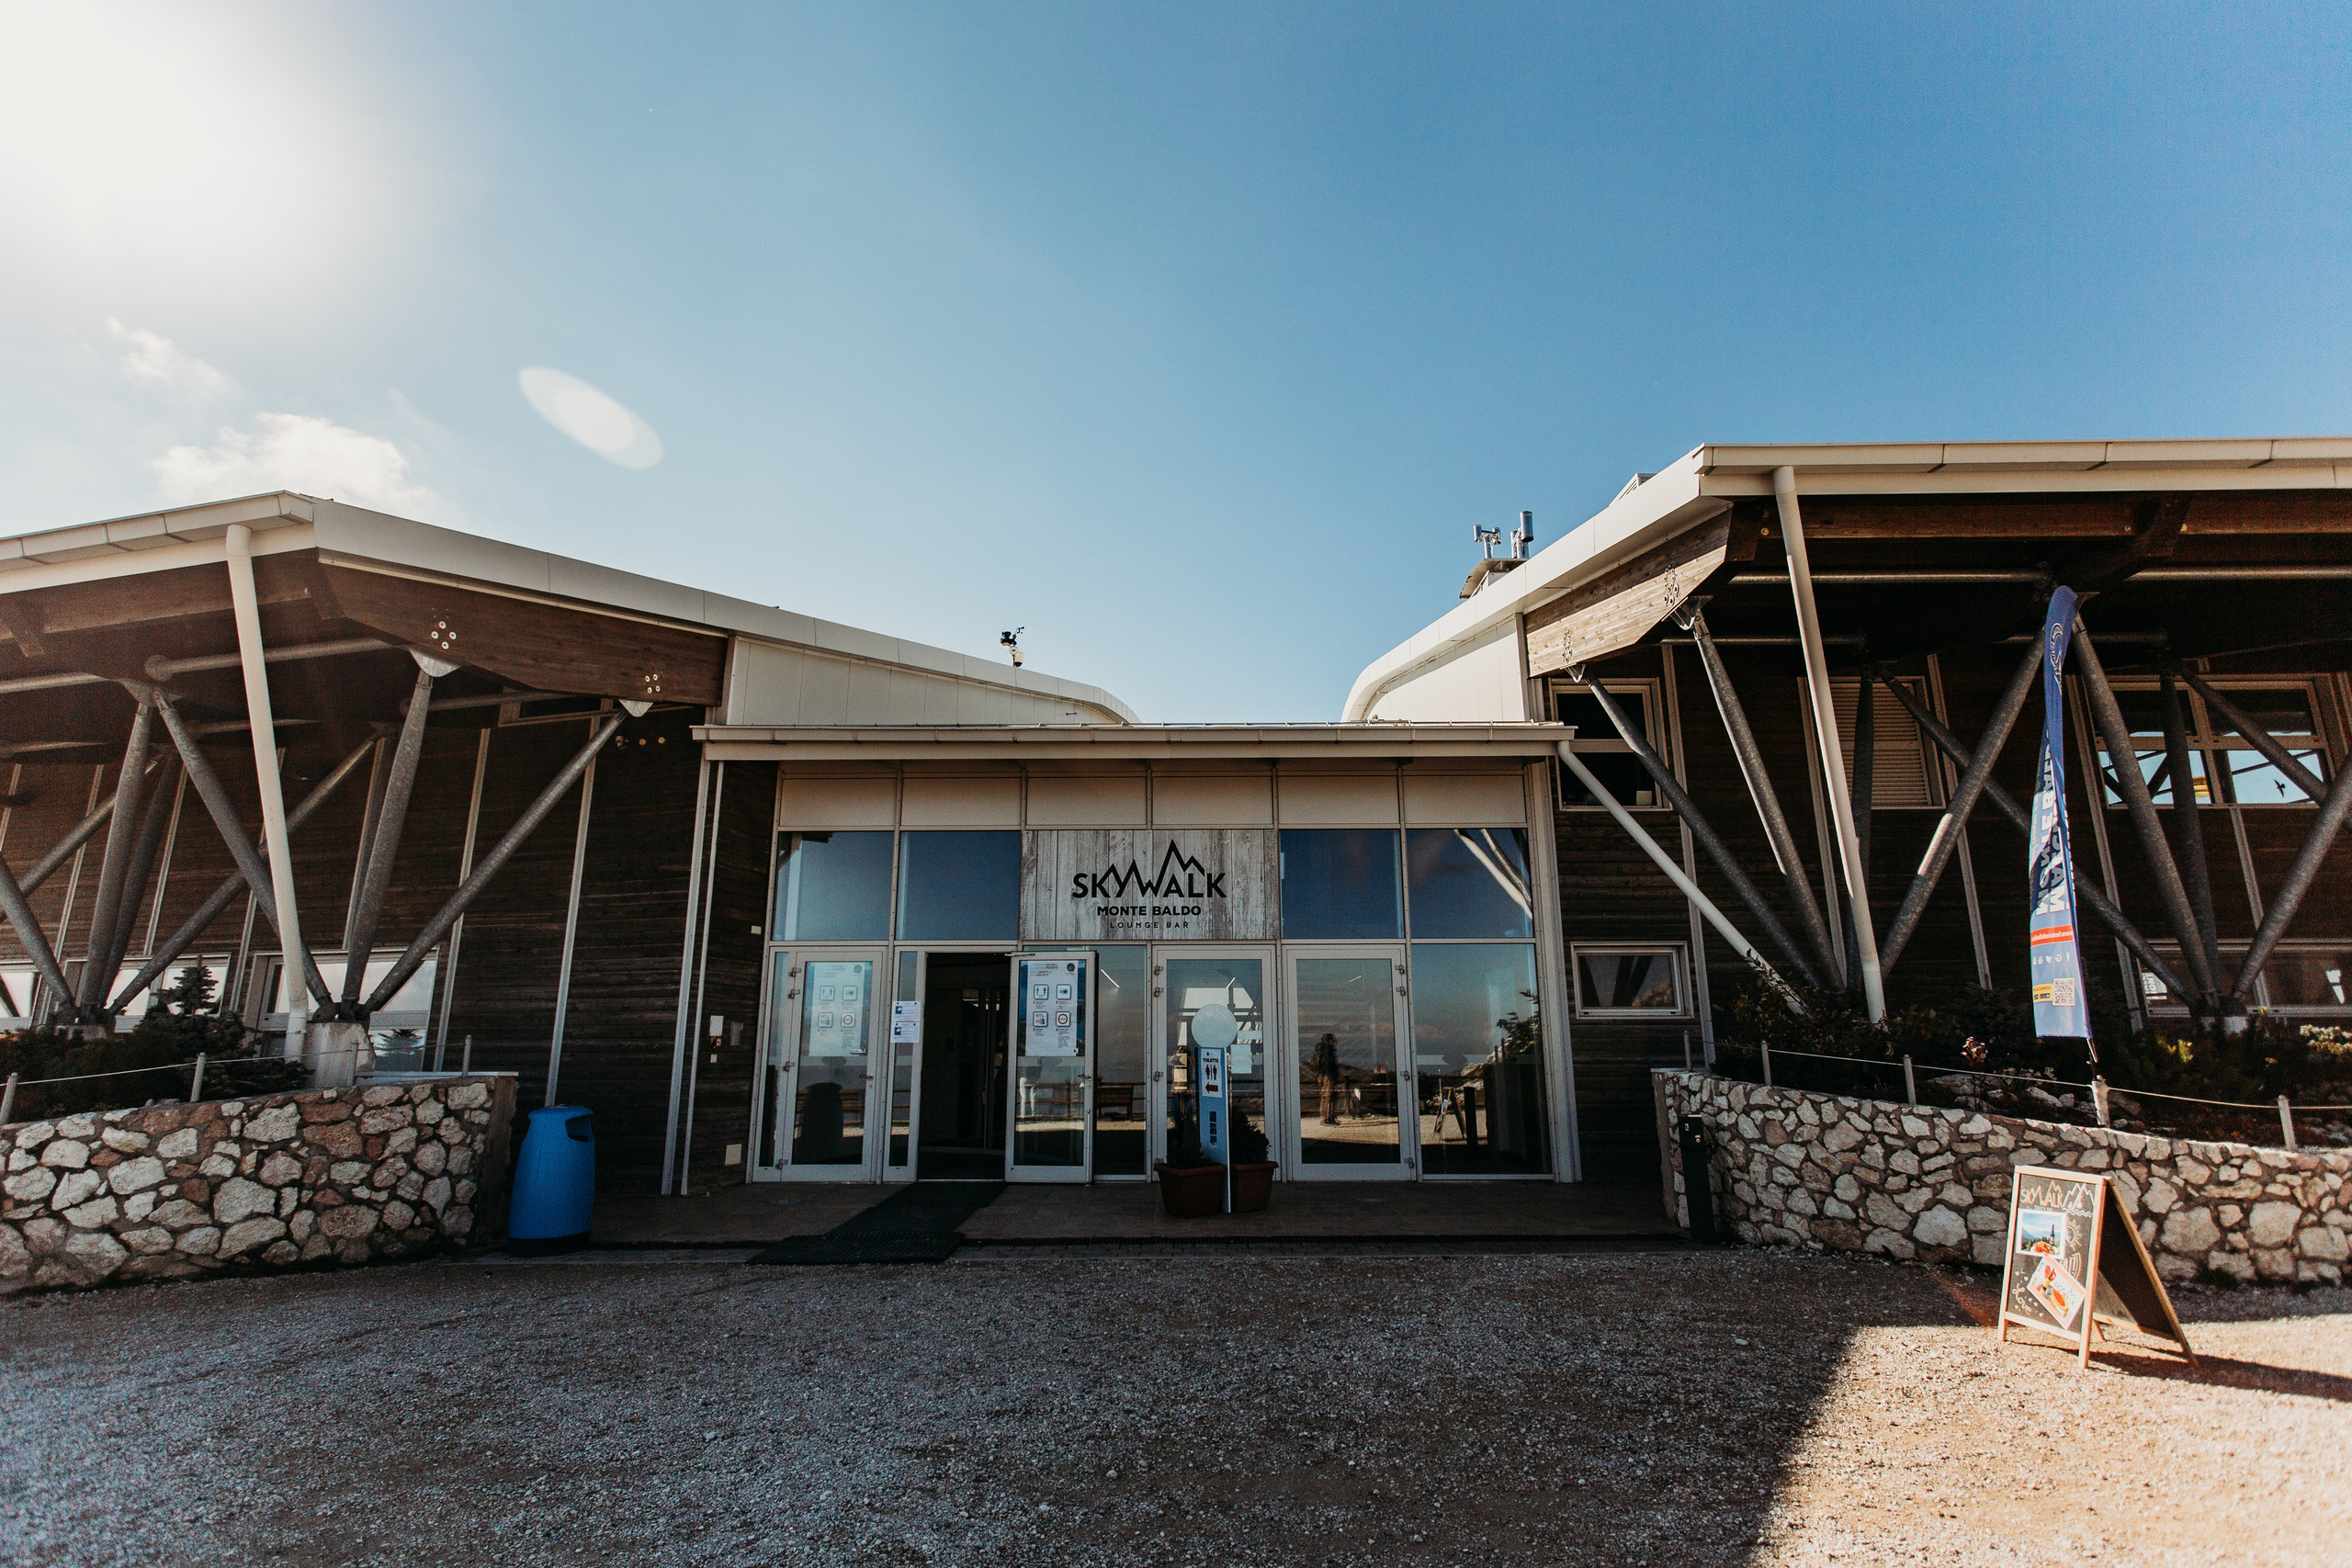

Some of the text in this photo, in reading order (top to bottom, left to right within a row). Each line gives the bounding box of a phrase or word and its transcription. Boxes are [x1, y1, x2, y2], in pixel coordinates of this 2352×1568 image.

[1071, 839, 1227, 898] SKYWALK
[1097, 906, 1202, 916] MONTE BALDO
[2020, 1179, 2064, 1209] SKYWALK
[2011, 1283, 2032, 1315] Love
